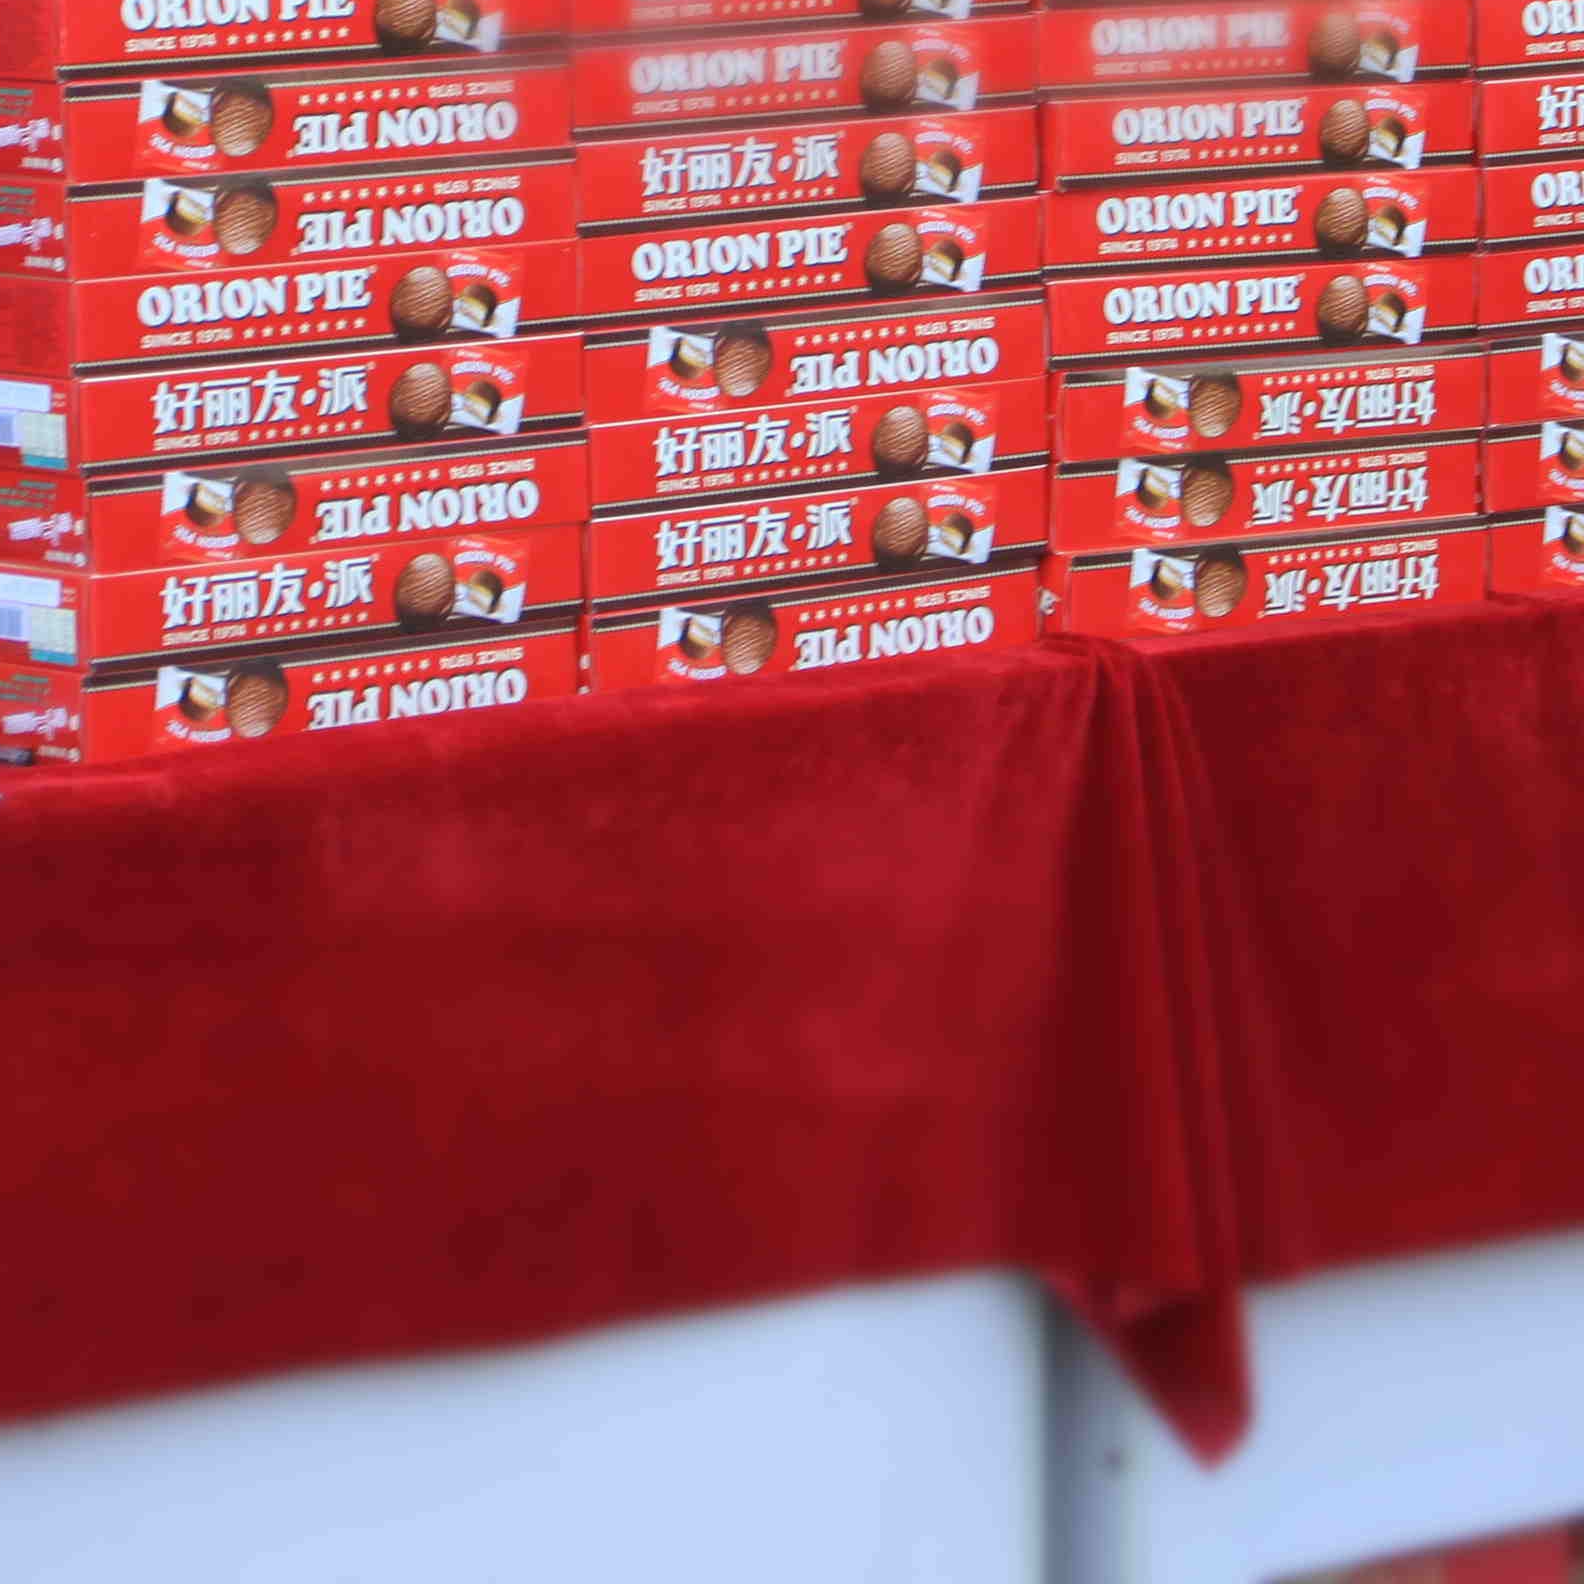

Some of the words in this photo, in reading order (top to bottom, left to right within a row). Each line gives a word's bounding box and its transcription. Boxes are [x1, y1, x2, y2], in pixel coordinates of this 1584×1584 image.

[124, 36, 176, 53] SINCE
[1092, 15, 1218, 56] ORION
[1226, 11, 1286, 47] PIE
[631, 47, 766, 93] ORION
[773, 41, 842, 82] PIE
[292, 111, 369, 158] PIE
[375, 101, 518, 149] ORION
[1113, 102, 1236, 145] ORION
[1239, 97, 1305, 138] PIE
[472, 175, 520, 192] SINCE
[296, 208, 374, 255] PIE
[380, 197, 524, 246] ORION
[1096, 191, 1226, 234] ORION
[1230, 186, 1300, 227] PIE
[631, 231, 771, 281] ORION
[775, 223, 851, 268] PIE
[136, 278, 288, 329] ORION
[294, 267, 374, 314] PIE
[1103, 280, 1230, 324] ORION
[1234, 275, 1302, 315] PIE
[141, 330, 190, 348] SINCE
[1106, 330, 1149, 344] SINCE
[788, 350, 862, 397] PIE
[866, 337, 1000, 387] ORION
[315, 495, 392, 544] PIE
[397, 479, 540, 532] ORION
[793, 624, 863, 671] PIE
[867, 606, 994, 660] ORION
[307, 686, 382, 731] PIE
[388, 668, 528, 720] ORION
